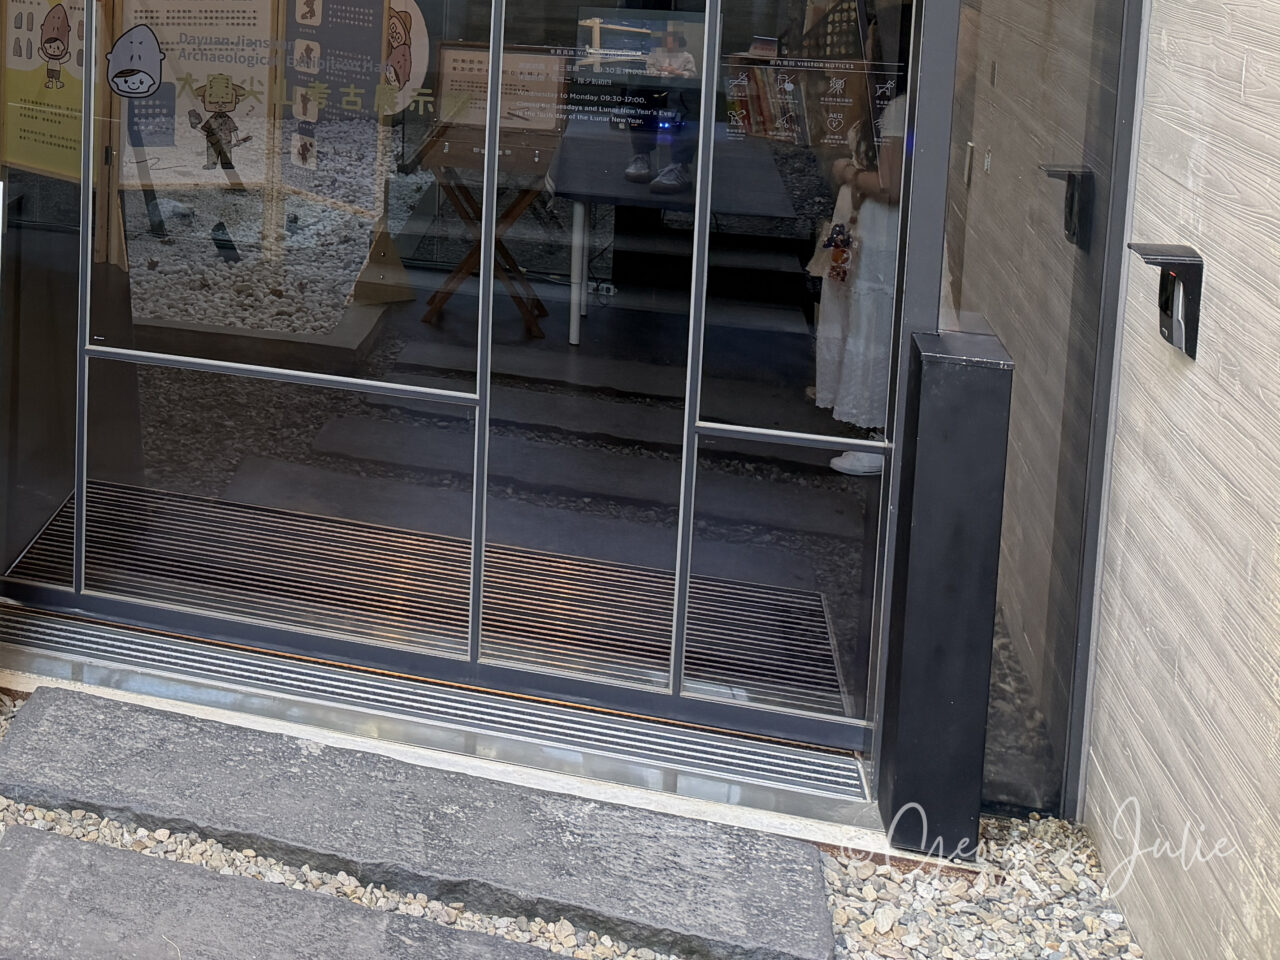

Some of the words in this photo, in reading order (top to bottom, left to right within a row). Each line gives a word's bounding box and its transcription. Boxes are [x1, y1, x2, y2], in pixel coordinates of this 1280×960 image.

[176, 72, 473, 120] 大園尖山考古展示
[570, 93, 598, 102] Monday
[556, 112, 567, 120] day
